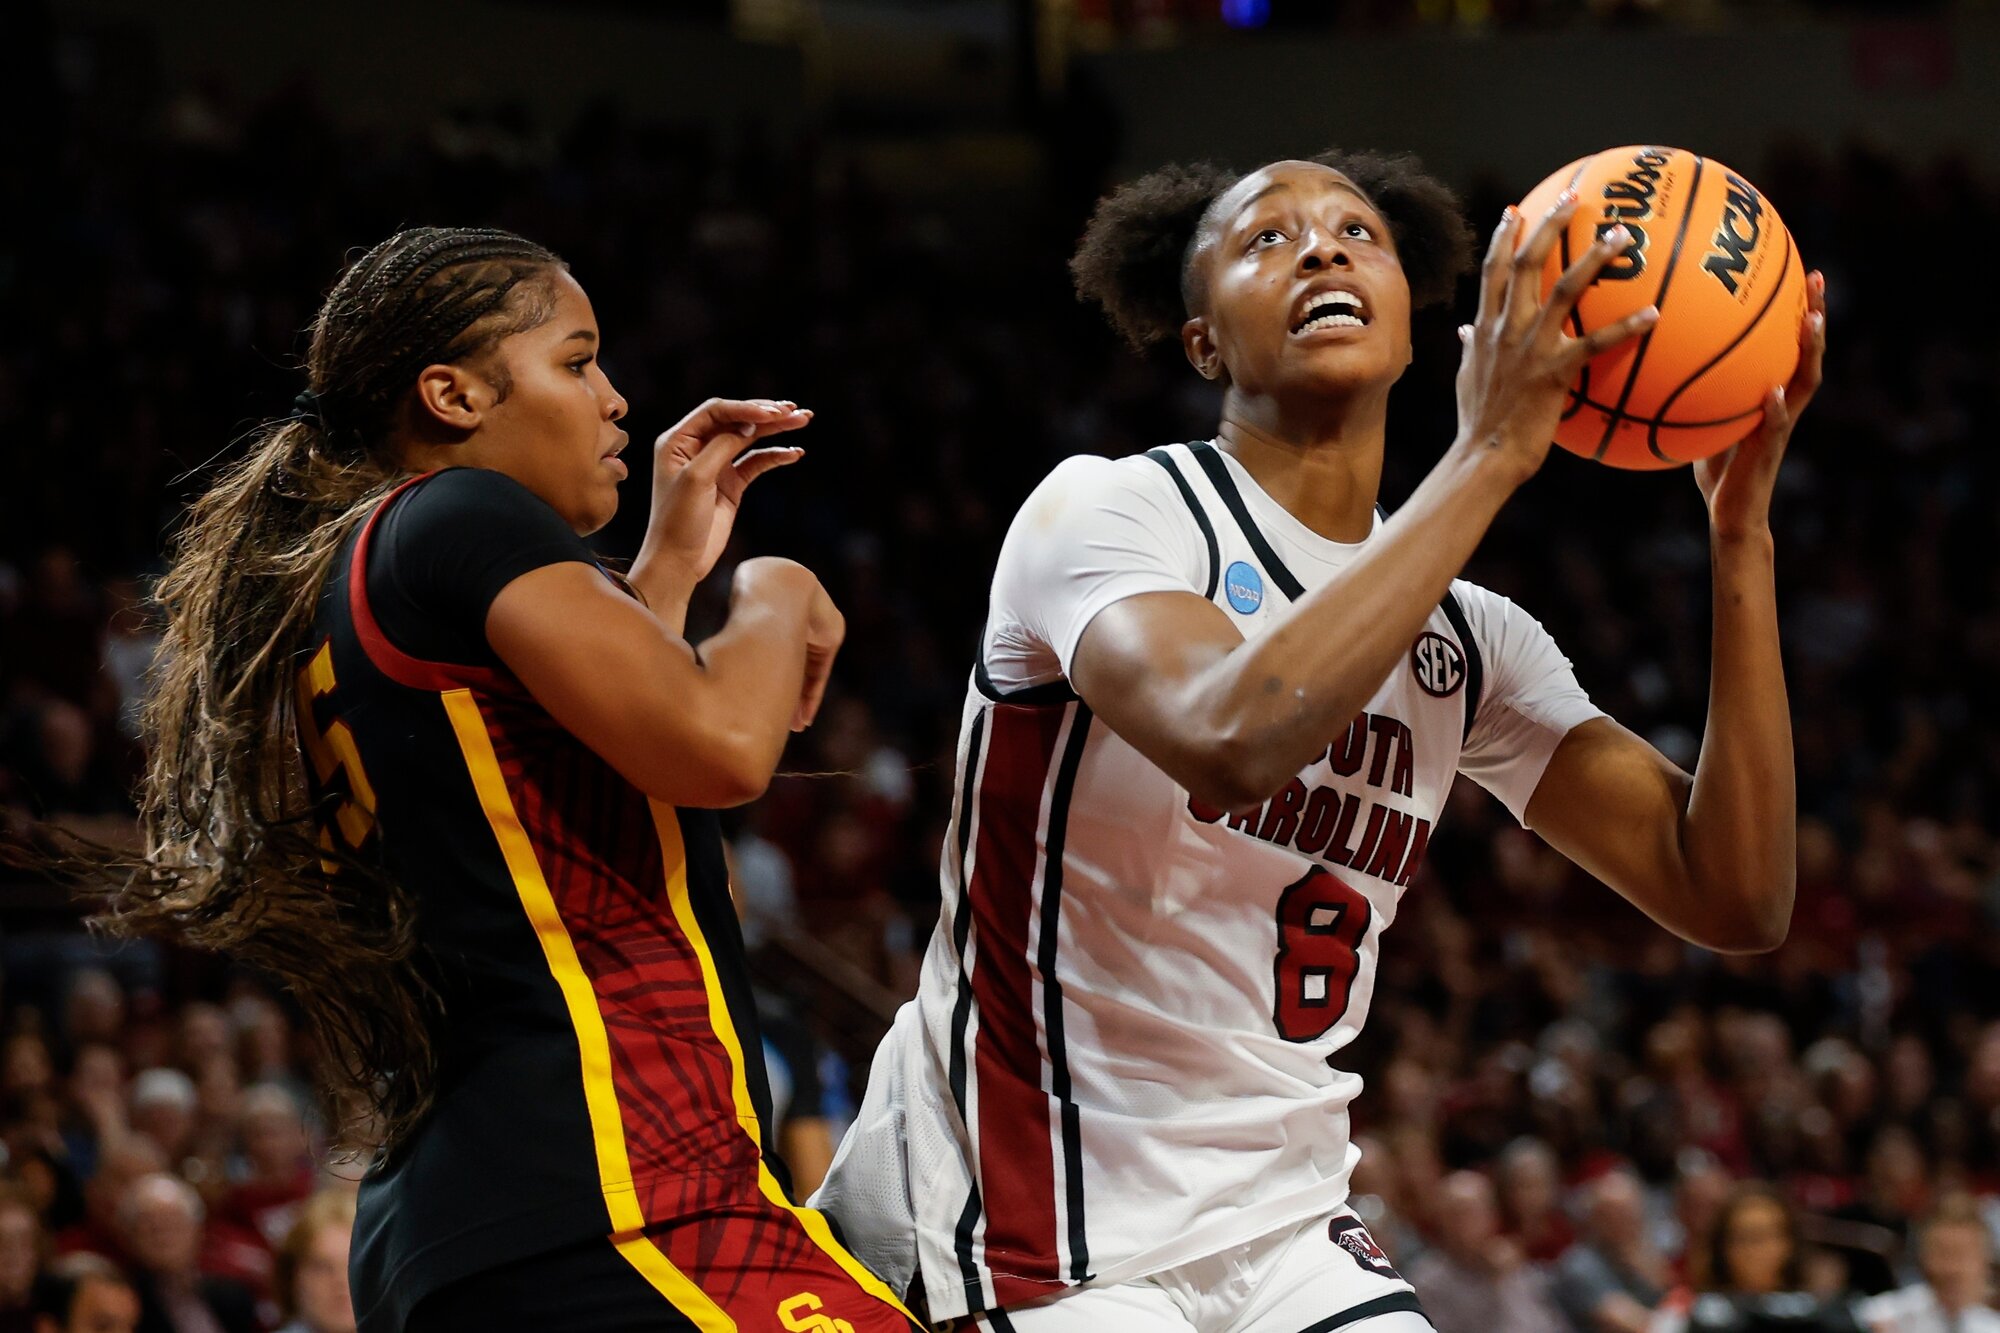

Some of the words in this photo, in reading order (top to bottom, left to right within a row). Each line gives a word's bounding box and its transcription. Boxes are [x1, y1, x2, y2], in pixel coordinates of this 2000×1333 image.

[1700, 173, 1764, 297] NCAA
[1229, 583, 1259, 603] NCAA
[1416, 636, 1461, 692] SEC
[1309, 711, 1414, 798] UTH
[1272, 864, 1371, 1042] 8
[776, 1291, 856, 1333] S
